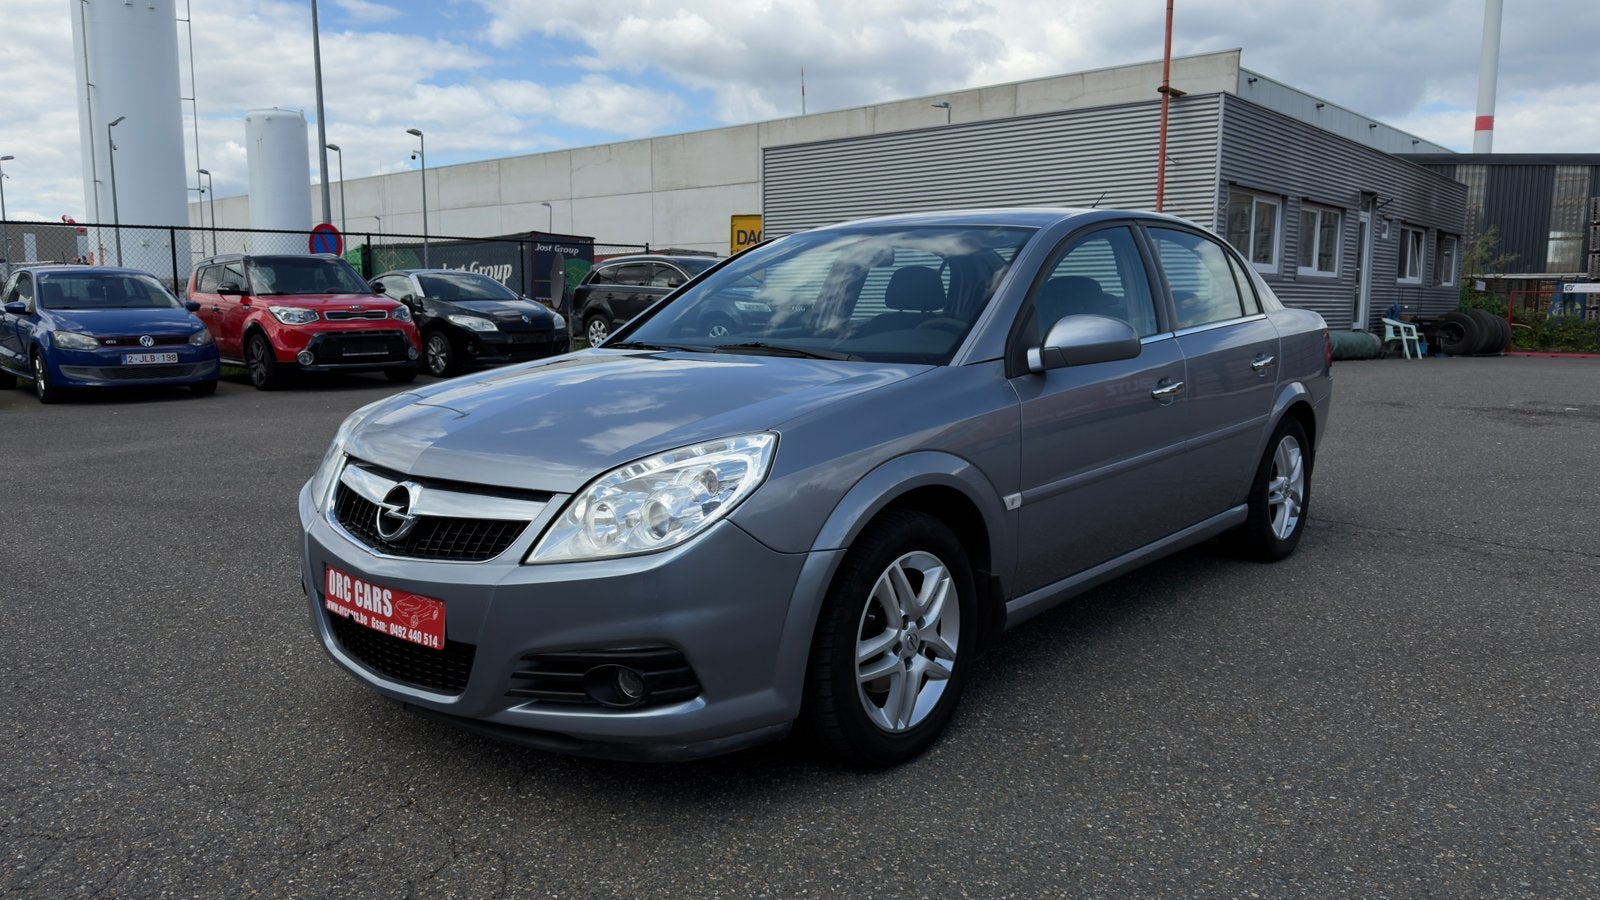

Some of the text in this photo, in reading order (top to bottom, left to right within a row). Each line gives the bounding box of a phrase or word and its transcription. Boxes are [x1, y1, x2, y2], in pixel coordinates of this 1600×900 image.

[535, 243, 552, 251] Jost
[554, 245, 579, 256] Group
[470, 261, 513, 286] Group
[328, 569, 393, 618] ORC CARS
[371, 616, 388, 633] Gsm:
[390, 622, 407, 639] 0492
[408, 629, 422, 645] 440
[423, 632, 438, 648] 514
